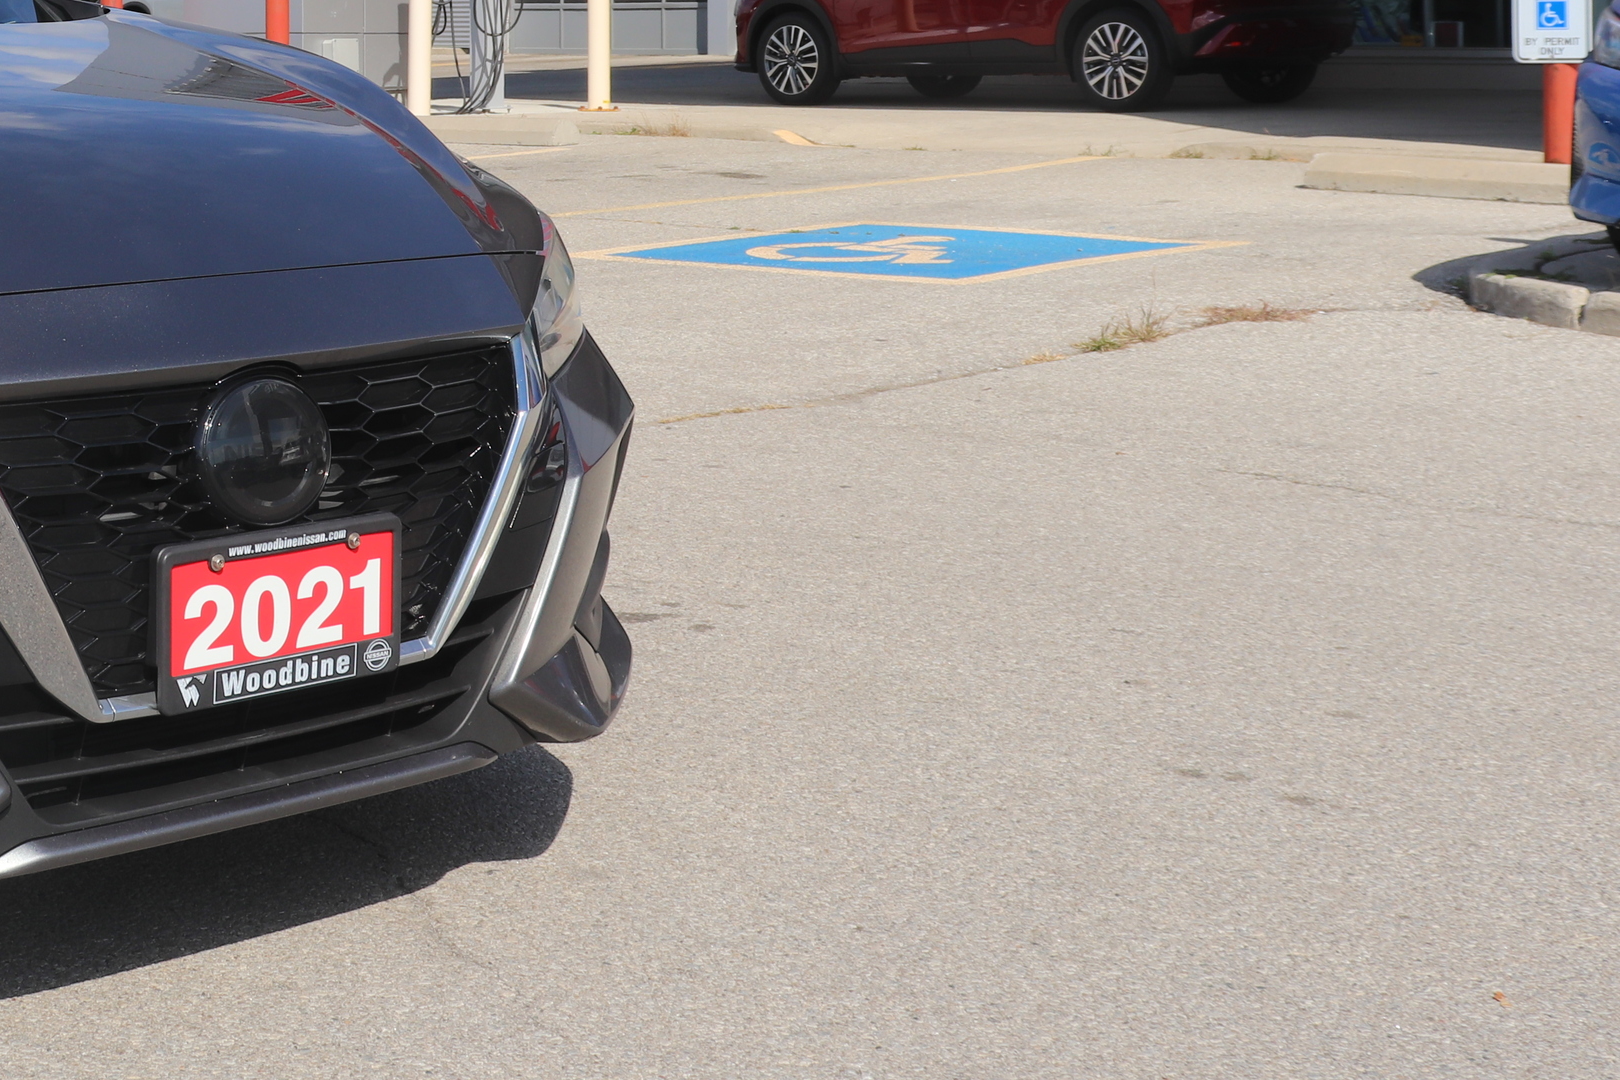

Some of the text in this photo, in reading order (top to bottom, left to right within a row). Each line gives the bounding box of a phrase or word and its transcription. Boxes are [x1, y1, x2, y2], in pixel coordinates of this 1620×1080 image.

[1525, 37, 1581, 46] BY PERMIT
[1540, 47, 1565, 56] ONLY
[228, 529, 347, 557] www.woodbinenissan.com
[183, 558, 381, 670] 2021
[221, 650, 389, 697] Woodbine NISSAN
